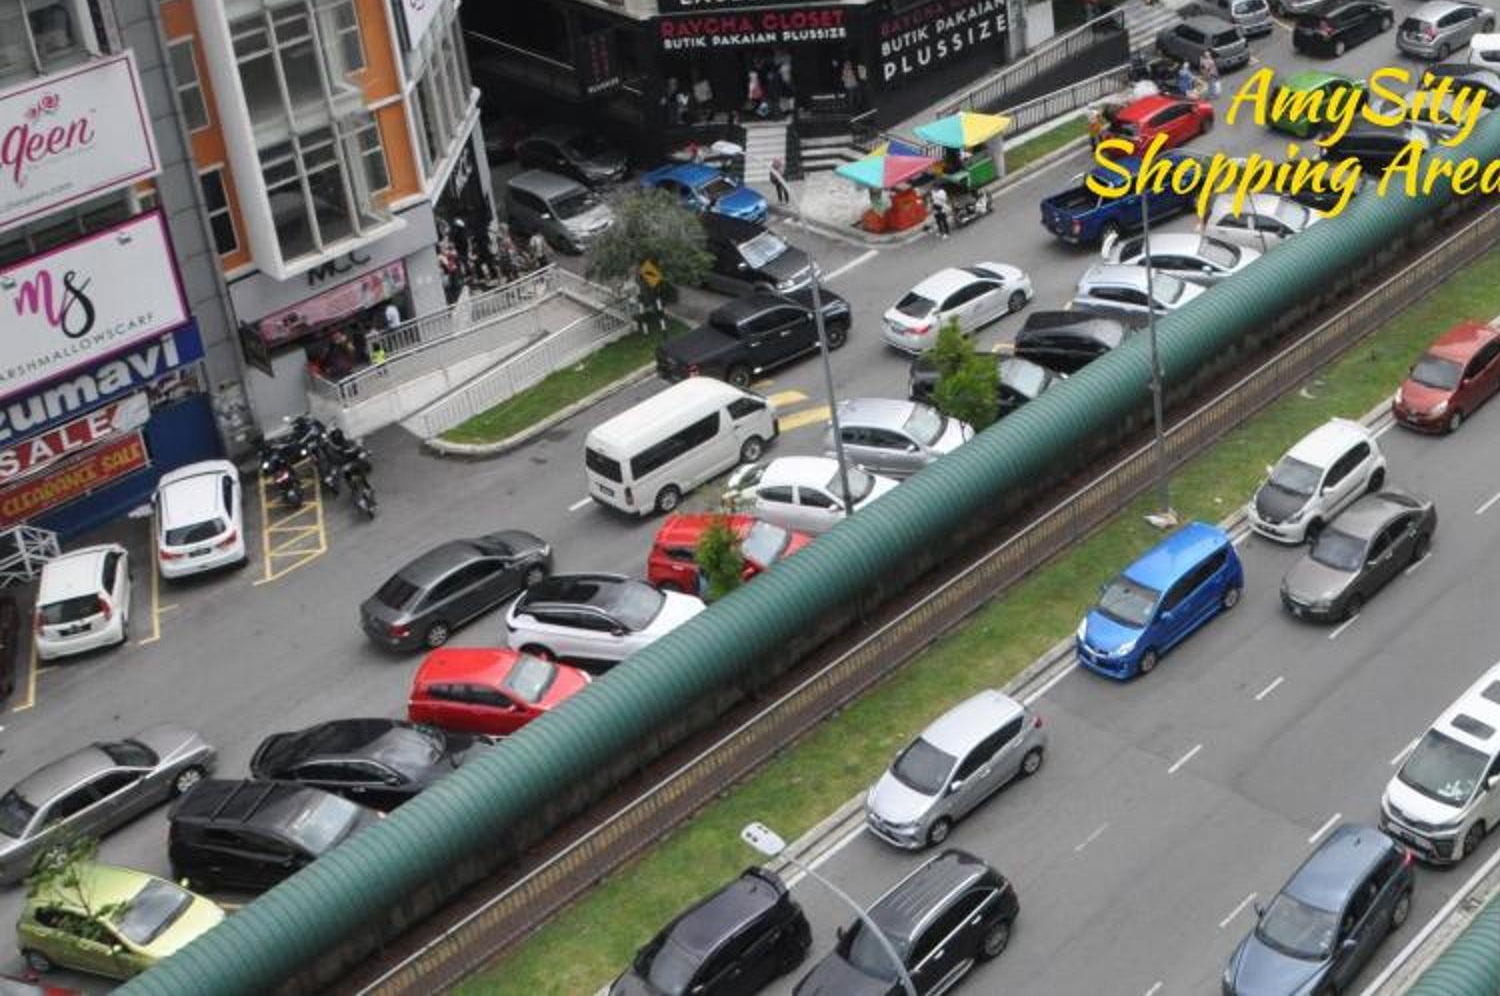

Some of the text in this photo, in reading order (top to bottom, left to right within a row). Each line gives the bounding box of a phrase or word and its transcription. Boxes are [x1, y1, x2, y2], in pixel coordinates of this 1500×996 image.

[762, 9, 846, 30] CLOSET
[664, 27, 848, 50] BUTIK PAKAIAN PLUSSIZE
[881, 24, 929, 57] BUTIK
[883, 14, 1007, 82] PLUSSIZE
[0, 408, 113, 477] SALE
[101, 442, 144, 469] SALE
